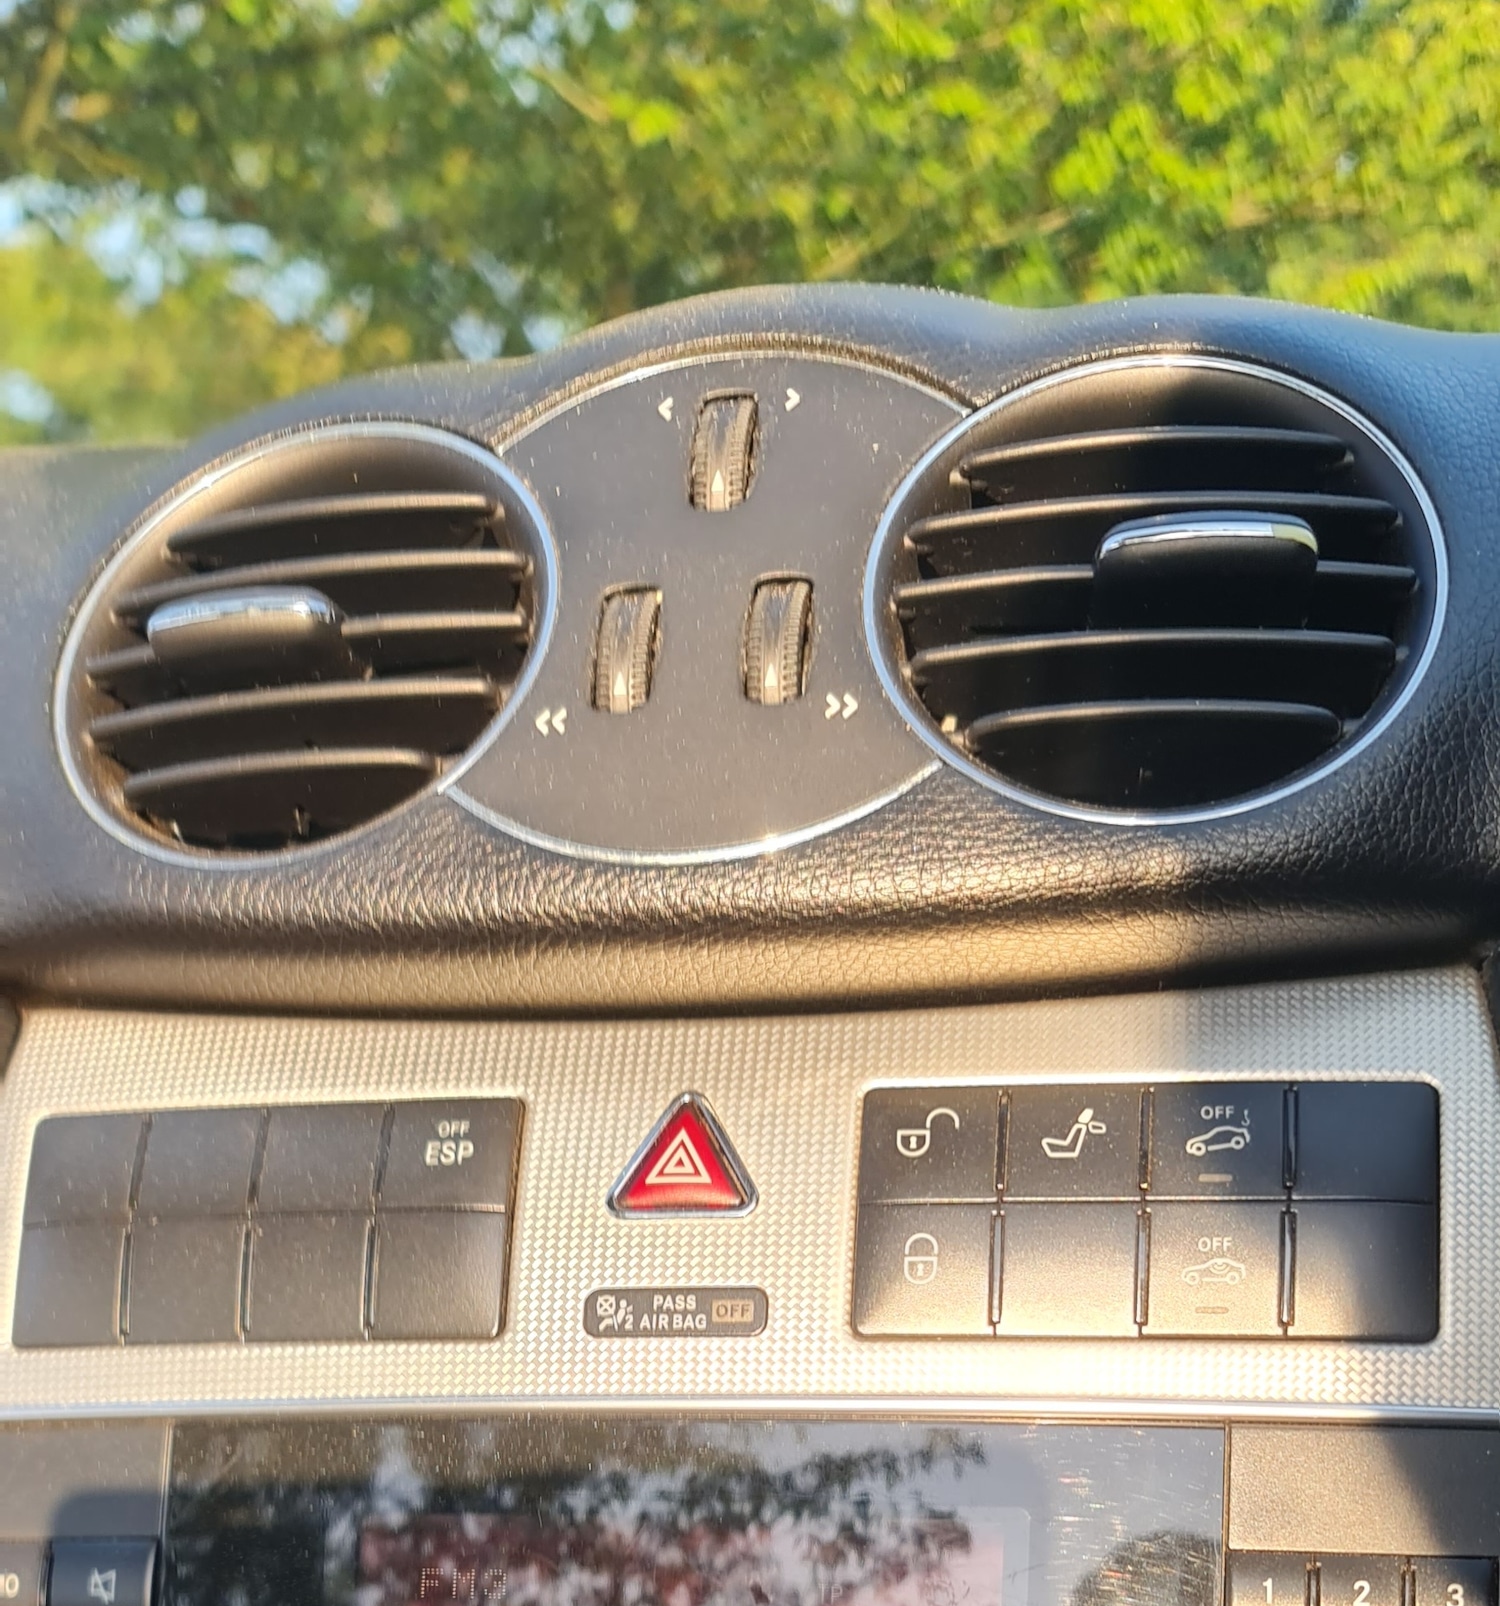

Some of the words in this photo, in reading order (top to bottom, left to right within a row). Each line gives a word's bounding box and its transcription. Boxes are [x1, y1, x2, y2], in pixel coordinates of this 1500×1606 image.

[1200, 1104, 1235, 1120] OFF
[438, 1120, 470, 1139] OFF
[425, 1140, 475, 1166] ESP
[1198, 1236, 1232, 1252] OFF
[653, 1294, 697, 1312] PASS
[716, 1303, 751, 1318] OFF
[420, 1567, 508, 1599] FM3
[1261, 1578, 1274, 1604] 1
